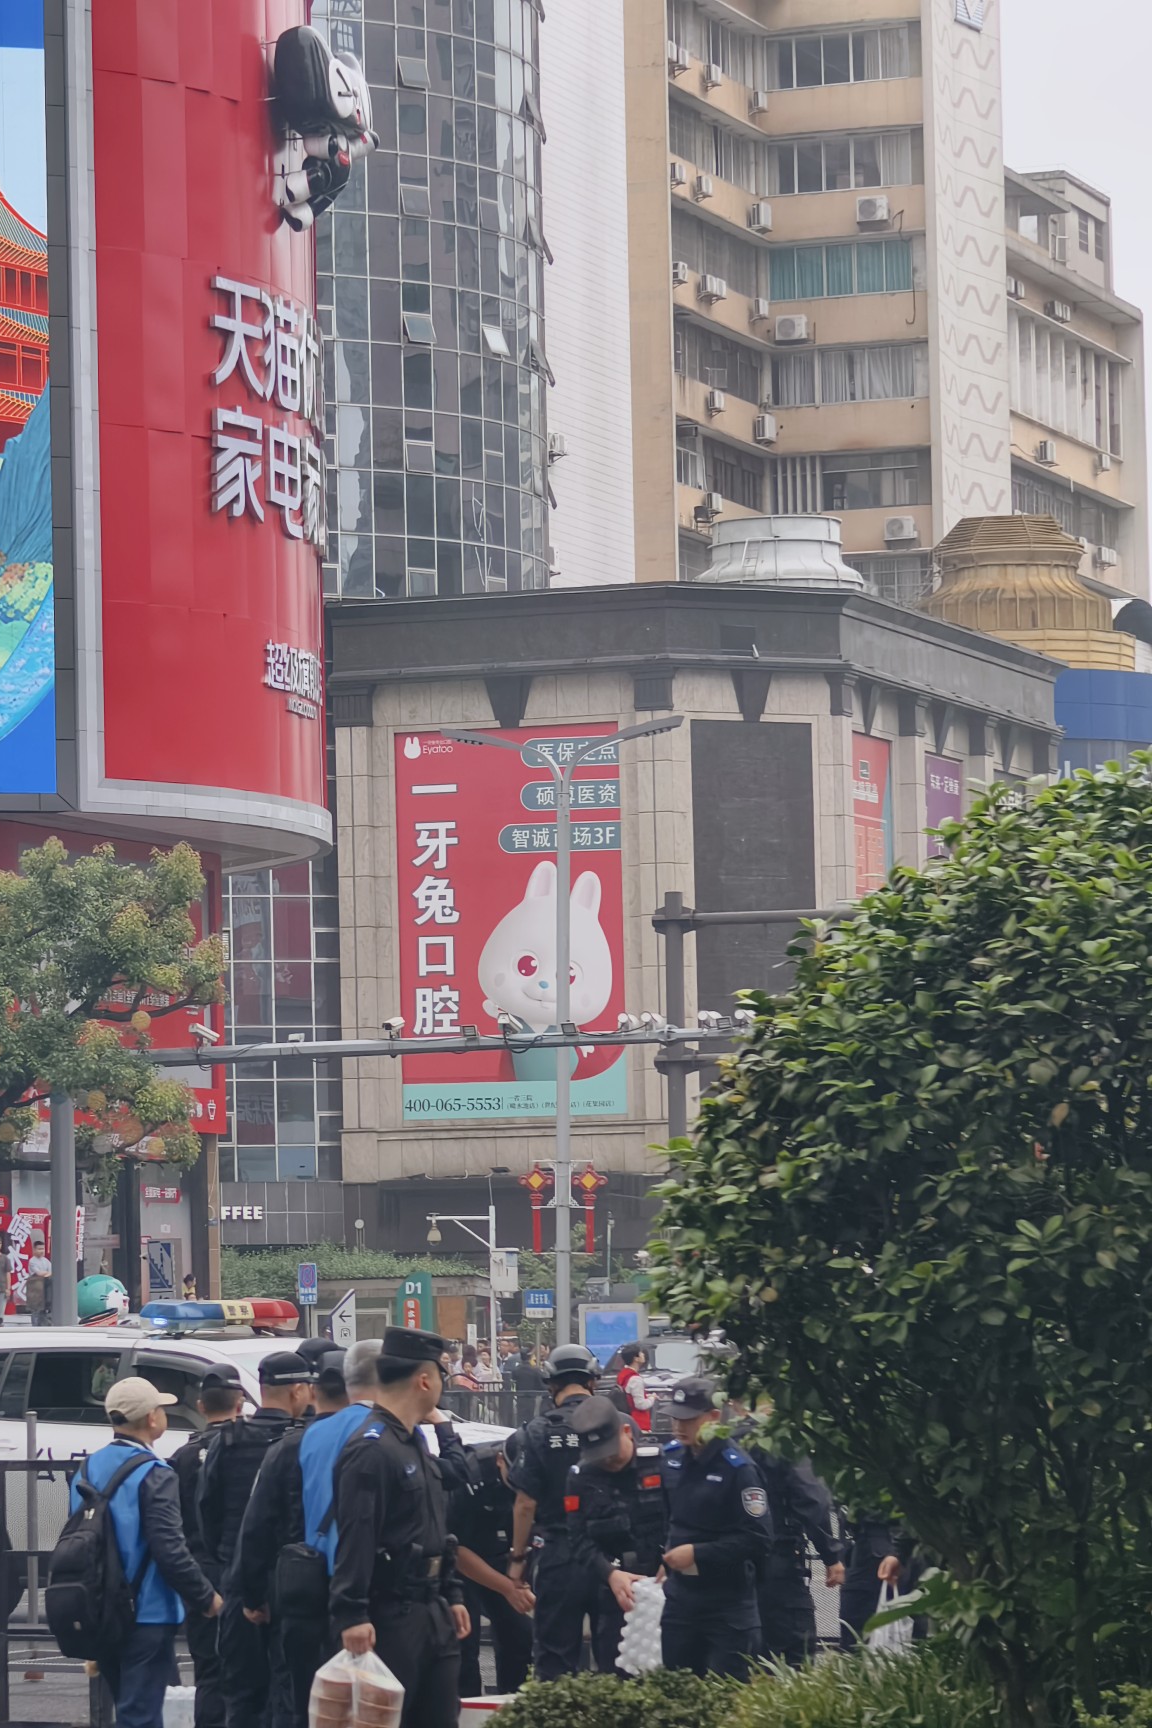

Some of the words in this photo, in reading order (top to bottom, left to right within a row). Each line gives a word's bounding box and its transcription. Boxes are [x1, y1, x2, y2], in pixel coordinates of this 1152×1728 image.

[411, 783, 462, 1036] 一牙兔口腔
[405, 1096, 501, 1113] 400-065-5553
[221, 1206, 263, 1220] FFEE
[405, 1281, 422, 1295] D1
